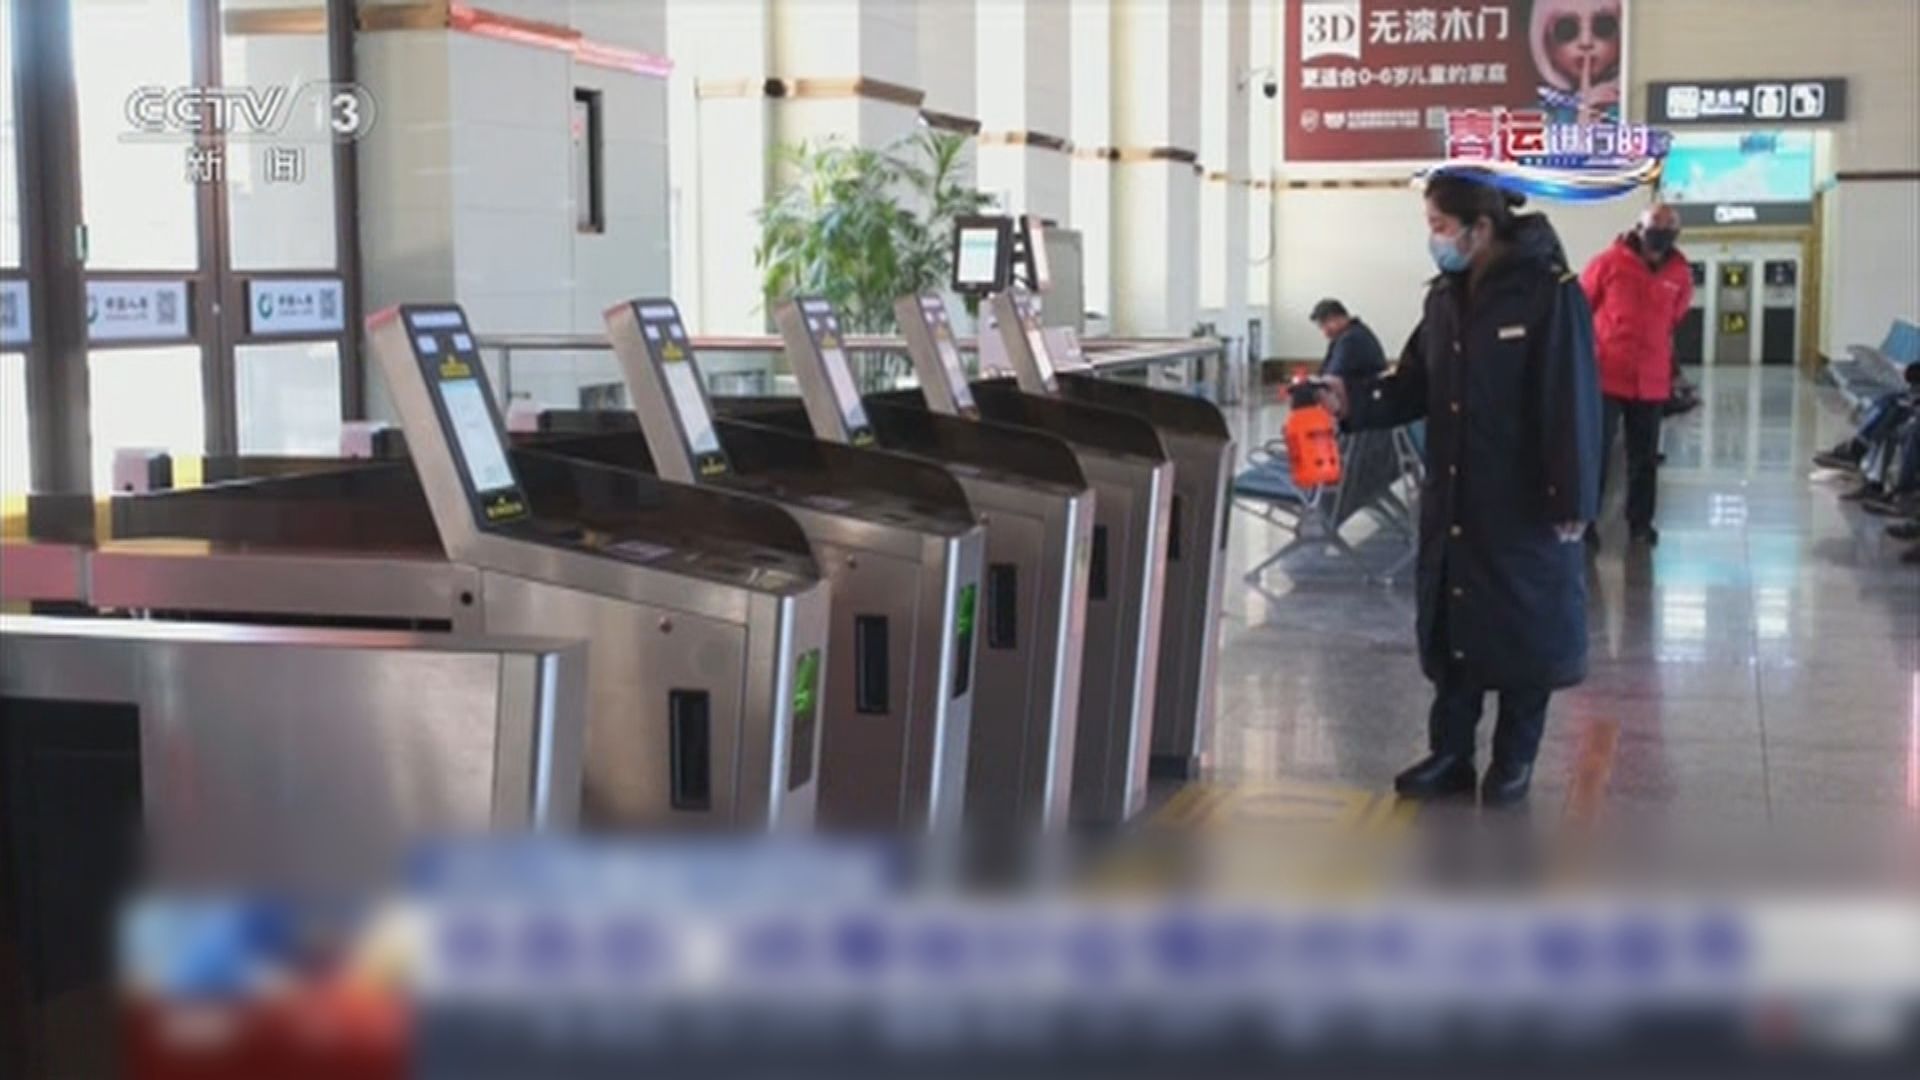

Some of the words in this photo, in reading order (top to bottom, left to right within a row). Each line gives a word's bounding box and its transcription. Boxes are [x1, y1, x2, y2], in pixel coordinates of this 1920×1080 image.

[1307, 15, 1356, 43] 3D
[1368, 7, 1508, 43] 无漆木门
[1302, 64, 1507, 88] 更适合0-6岁儿童的家庭
